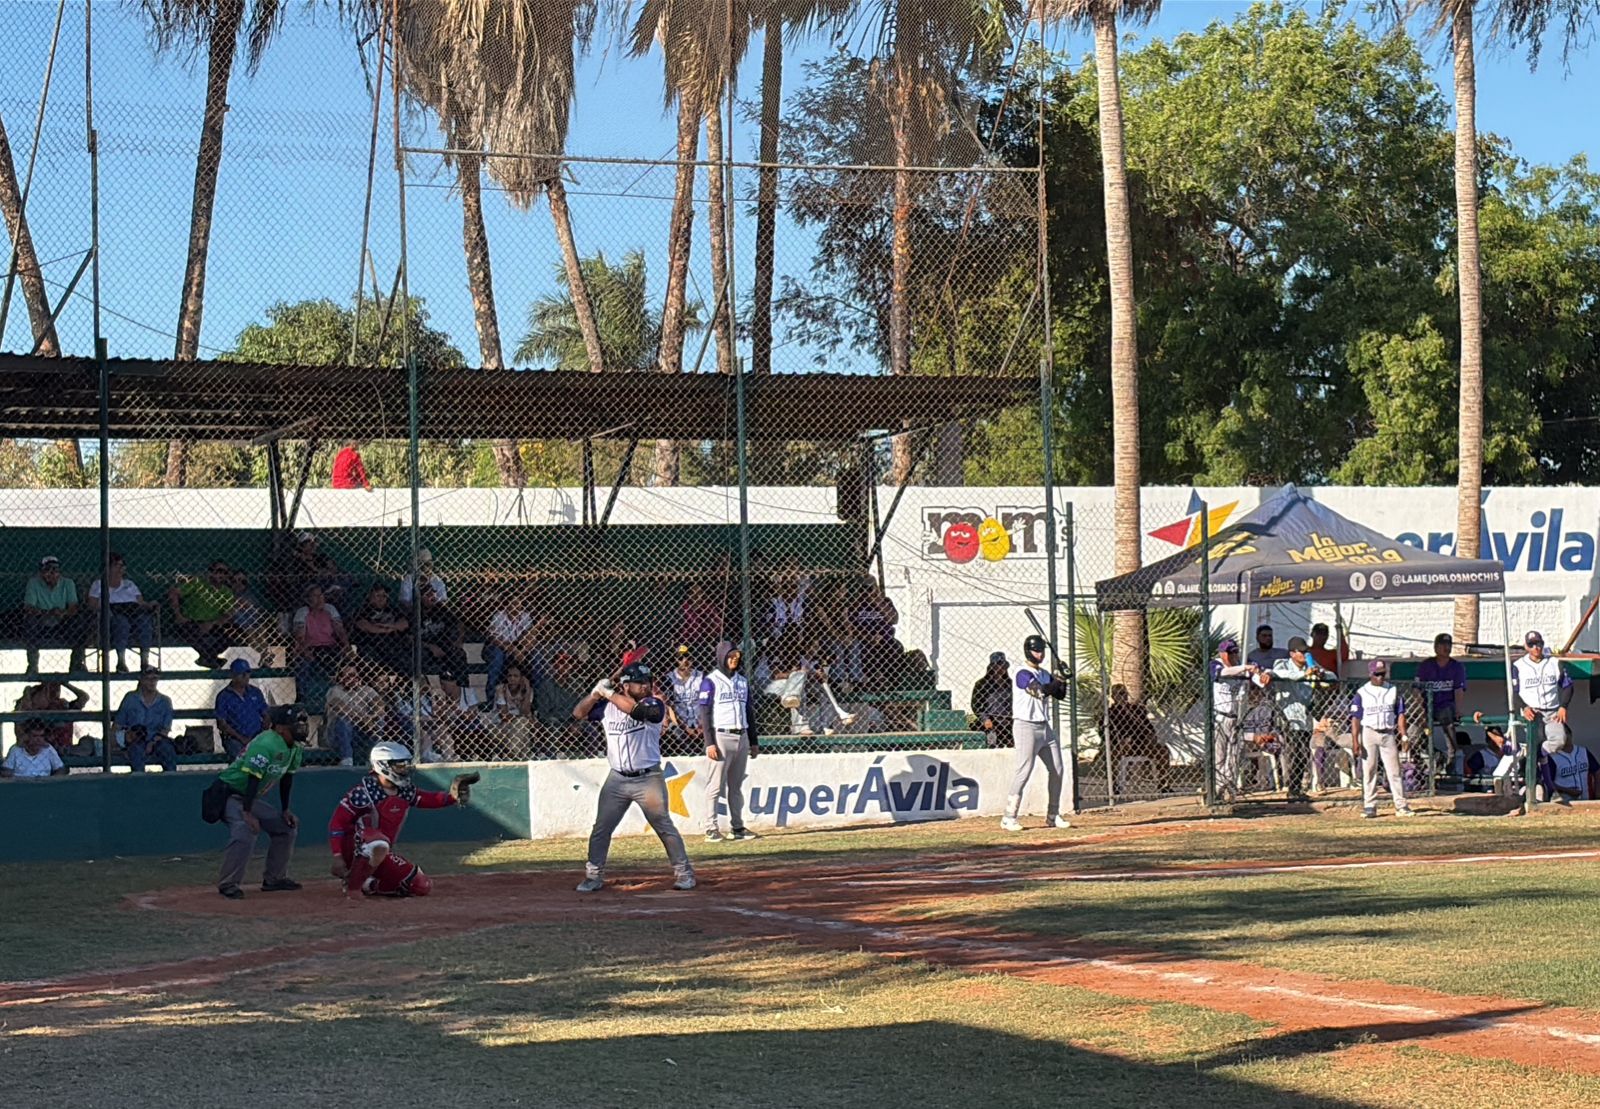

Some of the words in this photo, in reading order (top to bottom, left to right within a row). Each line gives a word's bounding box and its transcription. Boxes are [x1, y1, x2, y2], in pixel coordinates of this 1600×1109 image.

[1287, 543, 1367, 563] Mejor
[1299, 576, 1324, 595] 90.9
[1391, 572, 1499, 587] @LAMEJORLOSMOCHIS
[717, 755, 980, 827] uperÁvila
